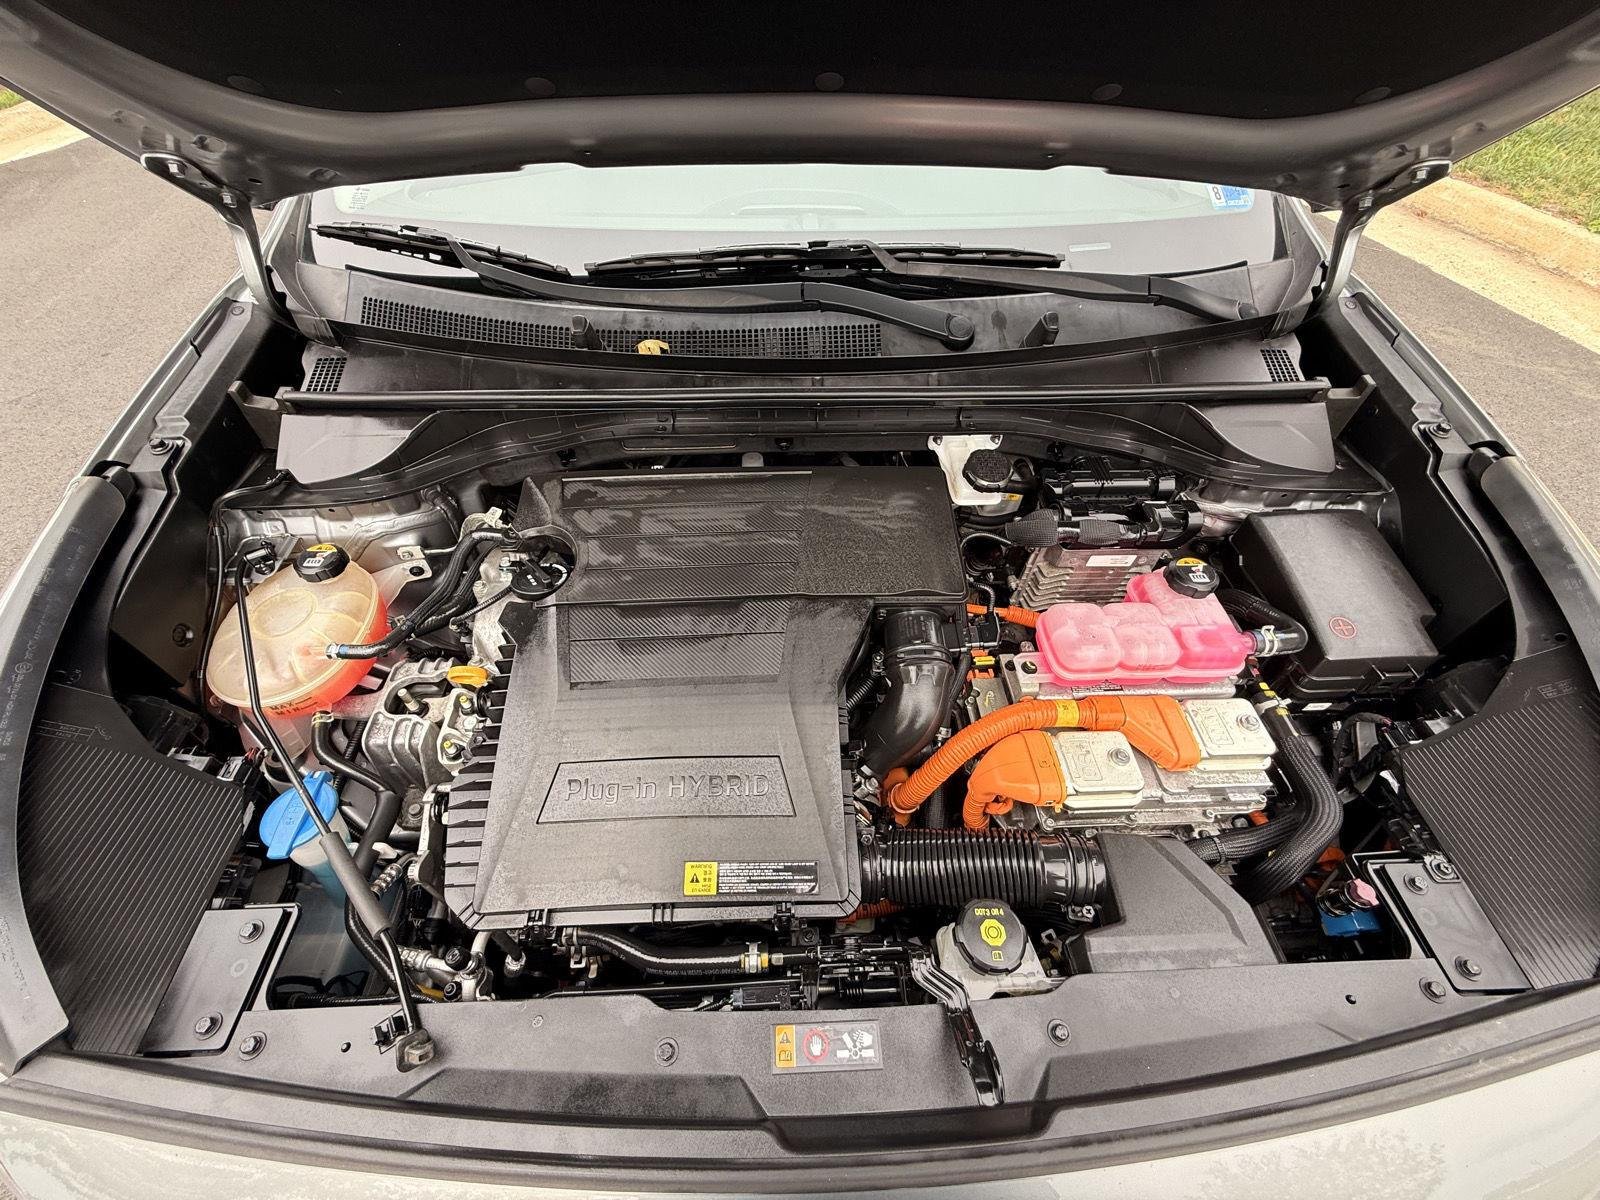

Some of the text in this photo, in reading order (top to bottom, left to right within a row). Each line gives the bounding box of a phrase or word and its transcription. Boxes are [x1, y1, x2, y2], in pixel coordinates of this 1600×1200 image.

[269, 701, 294, 711] MAX
[275, 706, 301, 716] MIN
[564, 774, 771, 806] Plug-in HYBRID
